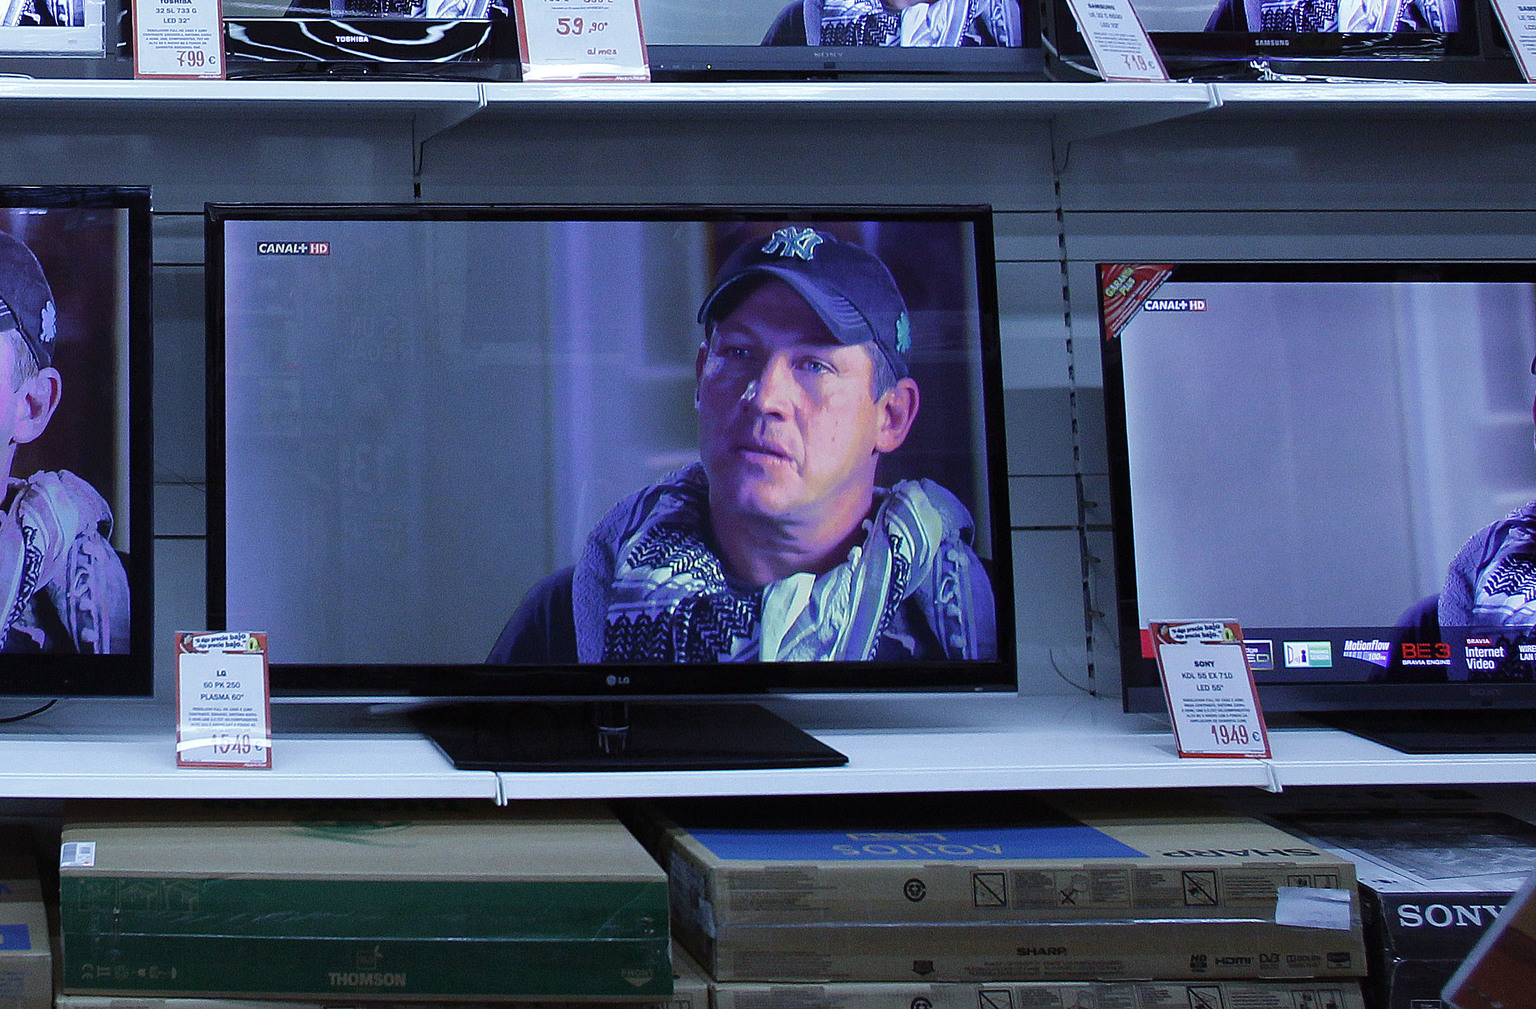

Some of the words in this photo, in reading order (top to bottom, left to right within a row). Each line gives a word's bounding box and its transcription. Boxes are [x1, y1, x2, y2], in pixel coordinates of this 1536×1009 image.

[556, 17, 584, 36] 59
[335, 35, 369, 43] TOSHIBA
[176, 50, 205, 67] 799
[258, 242, 308, 254] CANAL+
[309, 242, 328, 254] HD
[1144, 300, 1188, 311] CANAL+
[1189, 300, 1206, 311] HD
[1344, 639, 1391, 651] Motionflow
[1401, 642, 1432, 659] BE
[1434, 642, 1451, 659] 3
[1465, 646, 1504, 658] Internet
[1466, 658, 1495, 670] Video
[1211, 724, 1249, 745] 1949
[832, 843, 1004, 856] AQUOS
[1162, 848, 1321, 858] SHARP
[1016, 946, 1068, 957] SHARP
[327, 971, 408, 988] THOMSON
